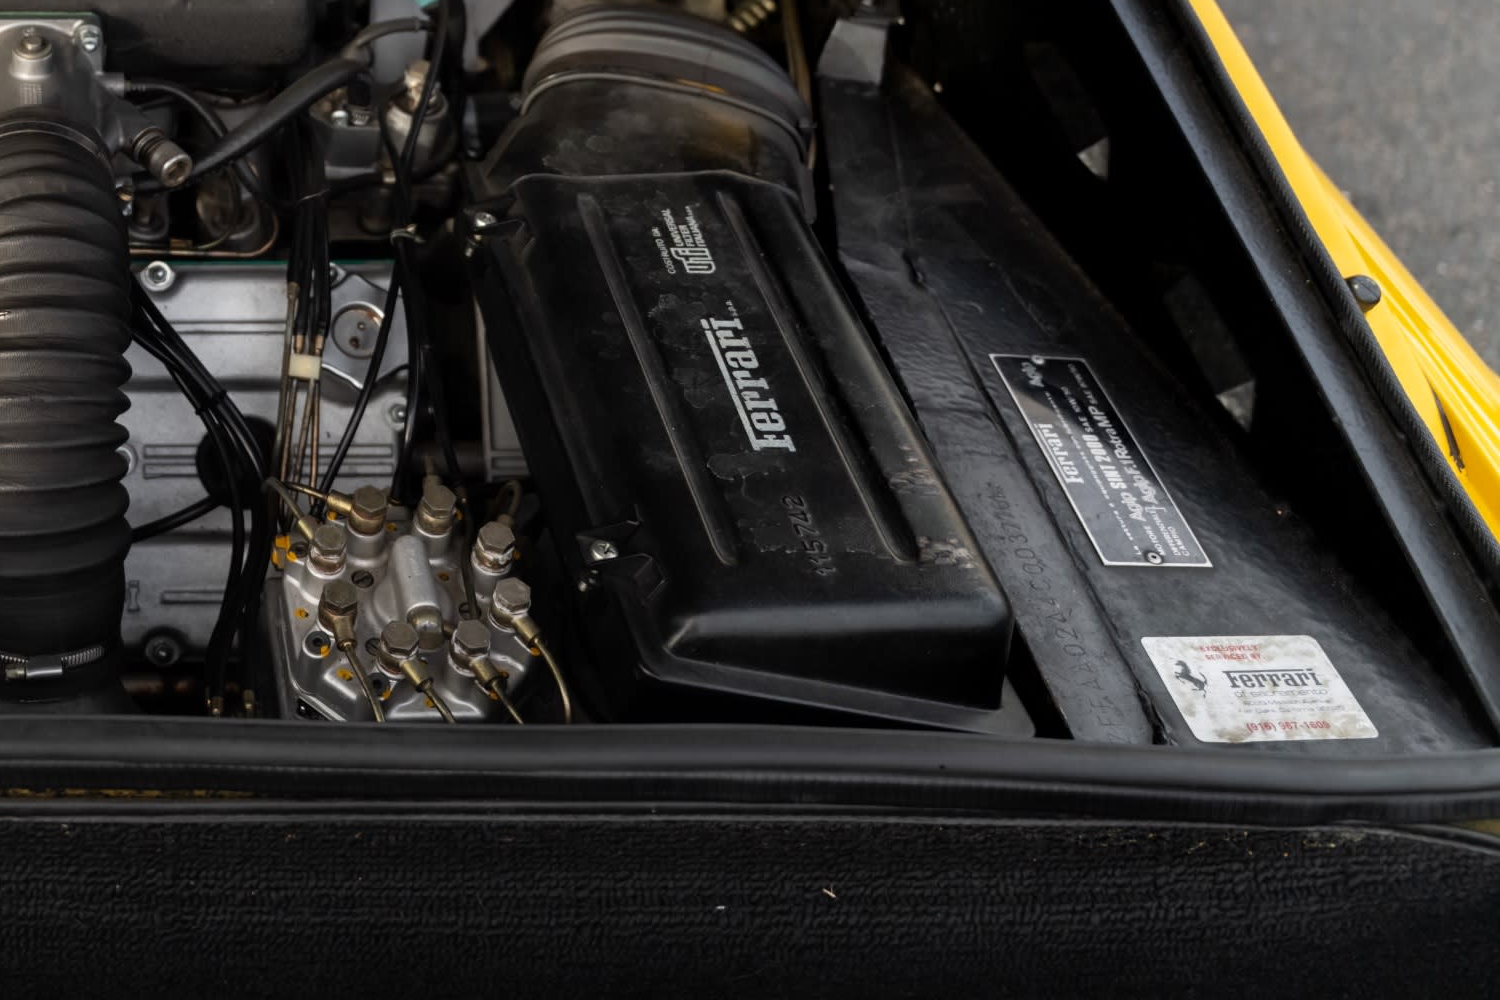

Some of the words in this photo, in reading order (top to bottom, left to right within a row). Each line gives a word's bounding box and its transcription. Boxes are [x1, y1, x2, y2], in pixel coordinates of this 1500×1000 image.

[661, 208, 684, 247] UNIVERSAL
[678, 225, 695, 247] FILTER
[685, 216, 707, 247] ITALIANA
[655, 238, 676, 274] COSTRUITO
[700, 317, 797, 453] Ferrari
[1078, 416, 1094, 433] SAE
[1033, 423, 1085, 484] Ferrari
[1082, 434, 1112, 463] 2000
[1100, 465, 1127, 490] SINT
[1132, 473, 1159, 504] Agip
[1120, 490, 1147, 522] Agip
[1143, 524, 1166, 556] MOTORE
[1222, 668, 1324, 689] Ferrari
